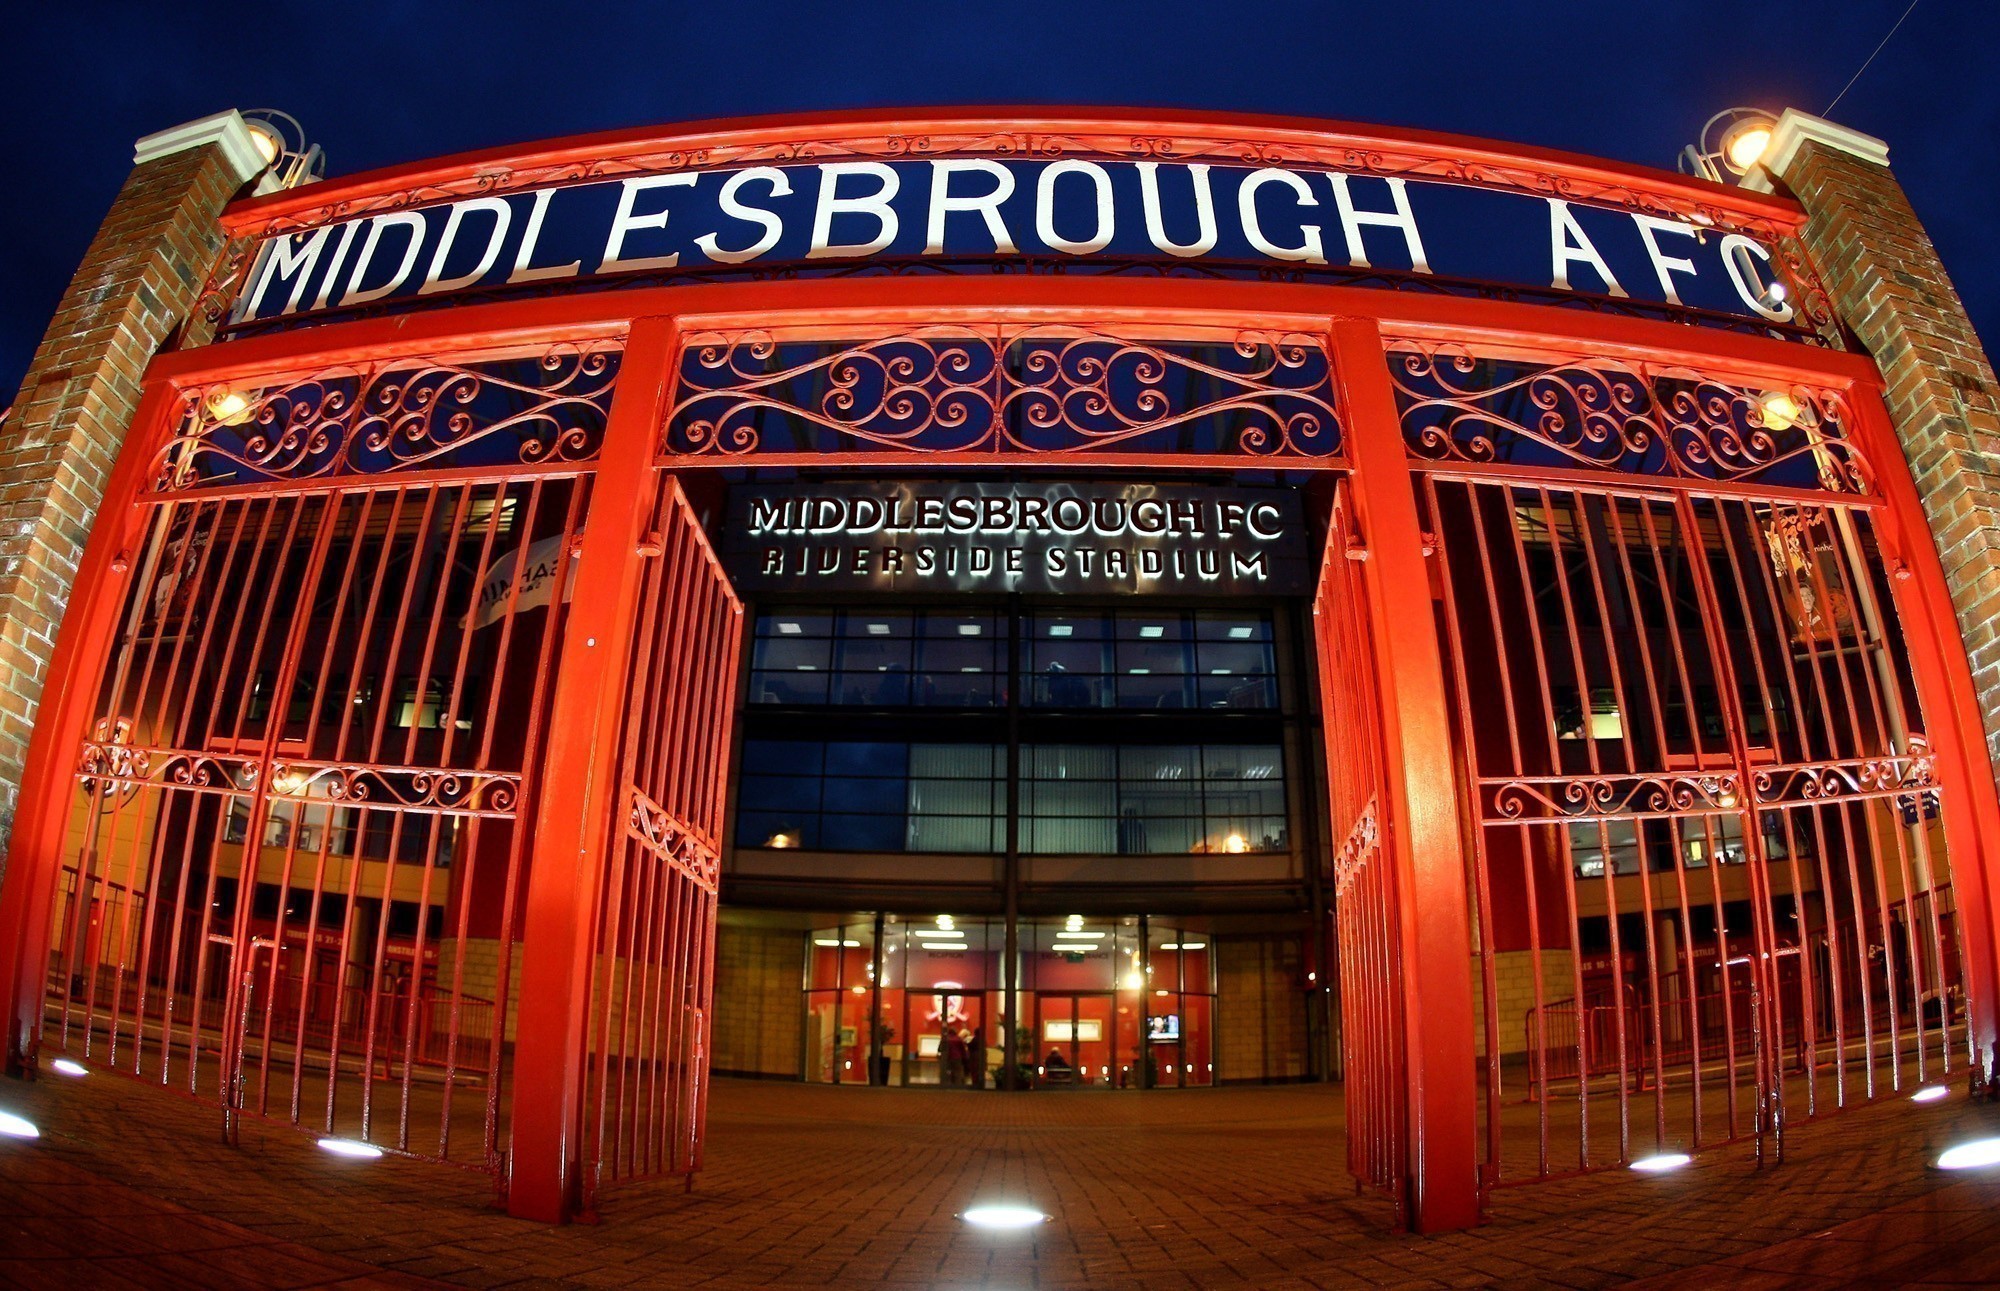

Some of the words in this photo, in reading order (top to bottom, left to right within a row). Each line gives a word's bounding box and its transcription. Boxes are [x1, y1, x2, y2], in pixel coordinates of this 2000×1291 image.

[245, 159, 1434, 322] MIDDLESBROUGH
[748, 496, 1205, 538] MIDDLESBROUGH
[1217, 502, 1284, 540] FC
[761, 545, 1025, 576] RIVERSIDE
[1046, 547, 1269, 580] STADIUM
